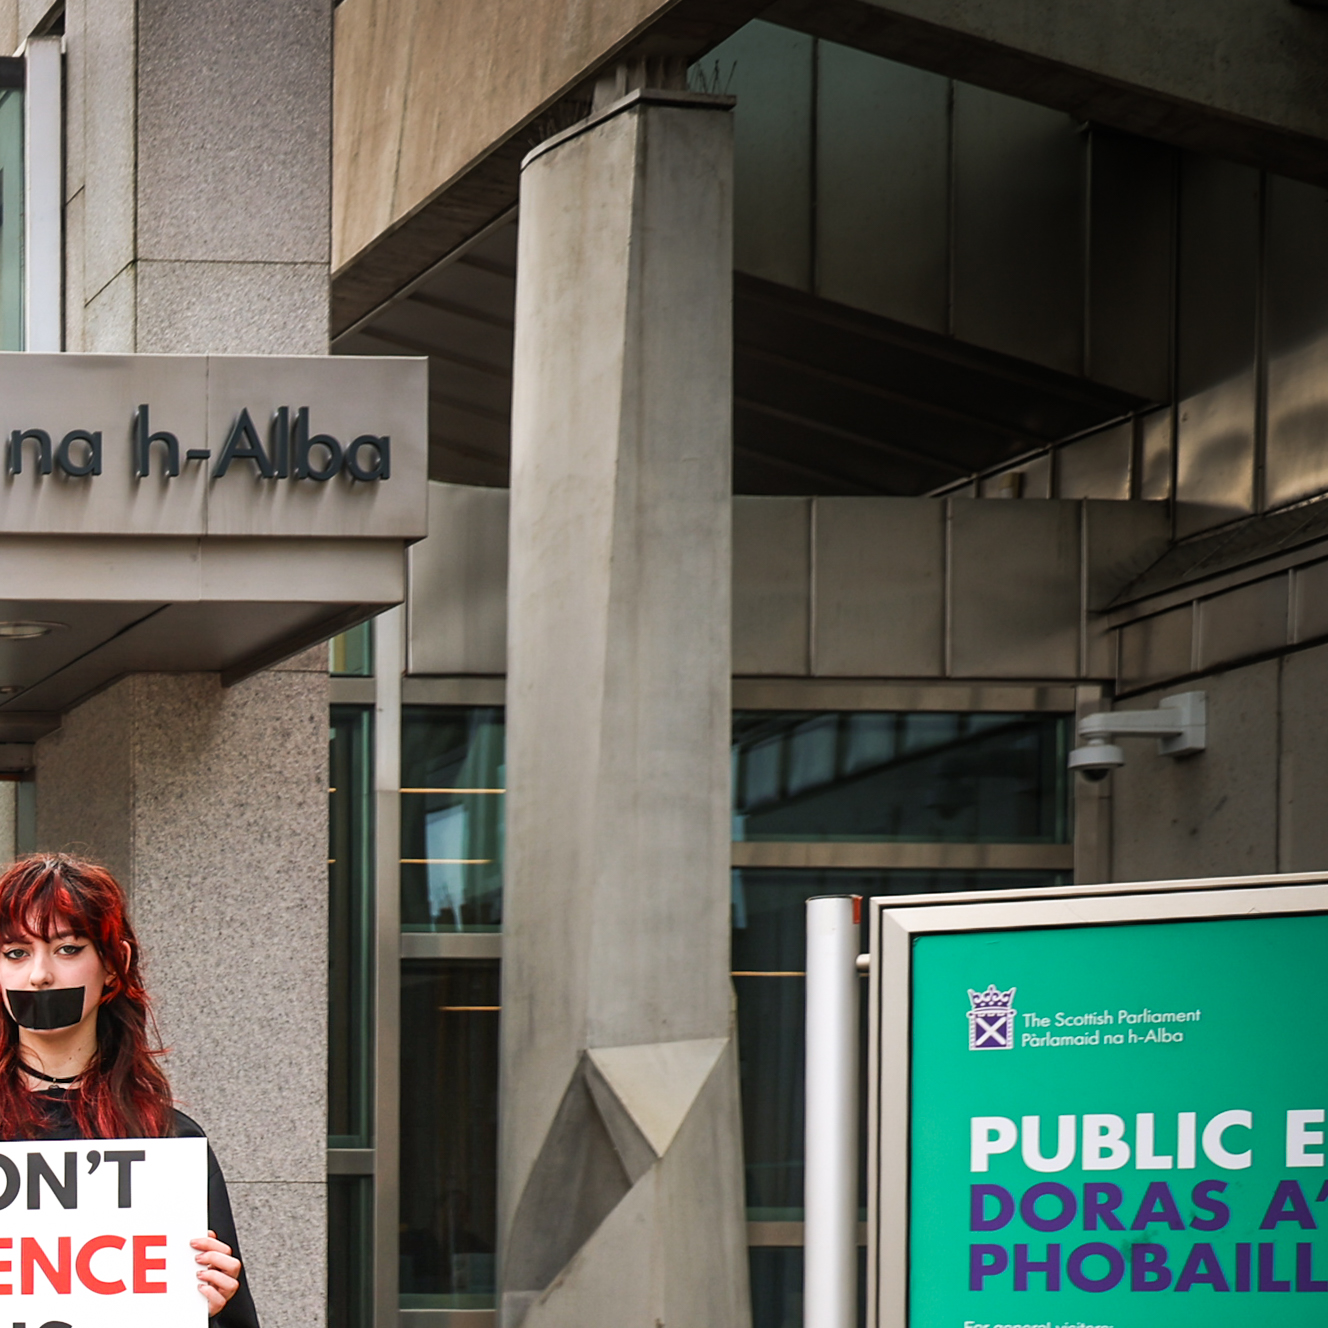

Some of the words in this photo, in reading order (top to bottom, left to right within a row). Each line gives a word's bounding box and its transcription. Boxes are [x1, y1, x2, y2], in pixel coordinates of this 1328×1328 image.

[8, 429, 102, 479] na
[133, 404, 390, 483] h-Alba
[1021, 1029, 1100, 1048] Pàrlamaid
[1103, 1033, 1124, 1046] na
[1127, 1027, 1184, 1044] h-Alba
[1022, 1011, 1051, 1028] The
[1054, 1009, 1114, 1027] Scottish
[1117, 1007, 1201, 1025] Parliament
[970, 1109, 1252, 1173] PUBLIC
[1285, 1108, 1325, 1169] E
[970, 1178, 1231, 1233] DORAS
[968, 1241, 1328, 1294] PHOBAILL
